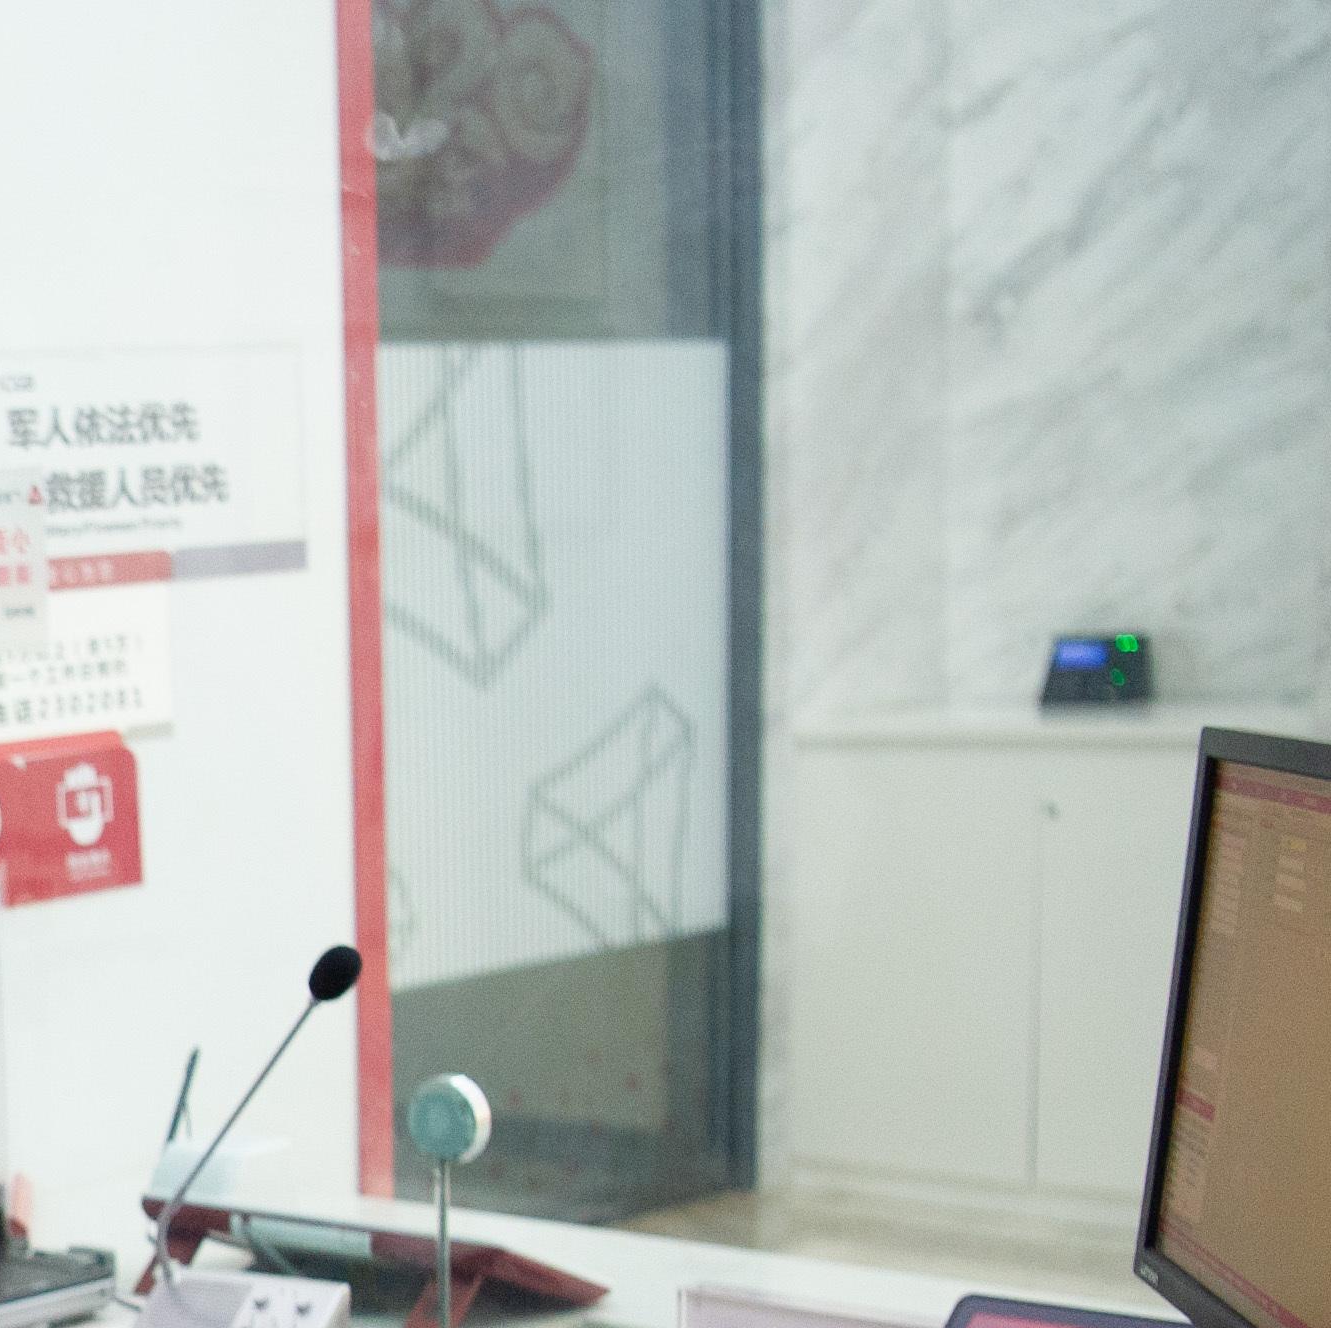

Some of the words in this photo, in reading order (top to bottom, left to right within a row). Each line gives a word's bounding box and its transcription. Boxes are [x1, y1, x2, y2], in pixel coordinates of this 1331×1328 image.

[6, 400, 200, 448] 军人依法优先
[45, 463, 229, 512] 救援人员优先
